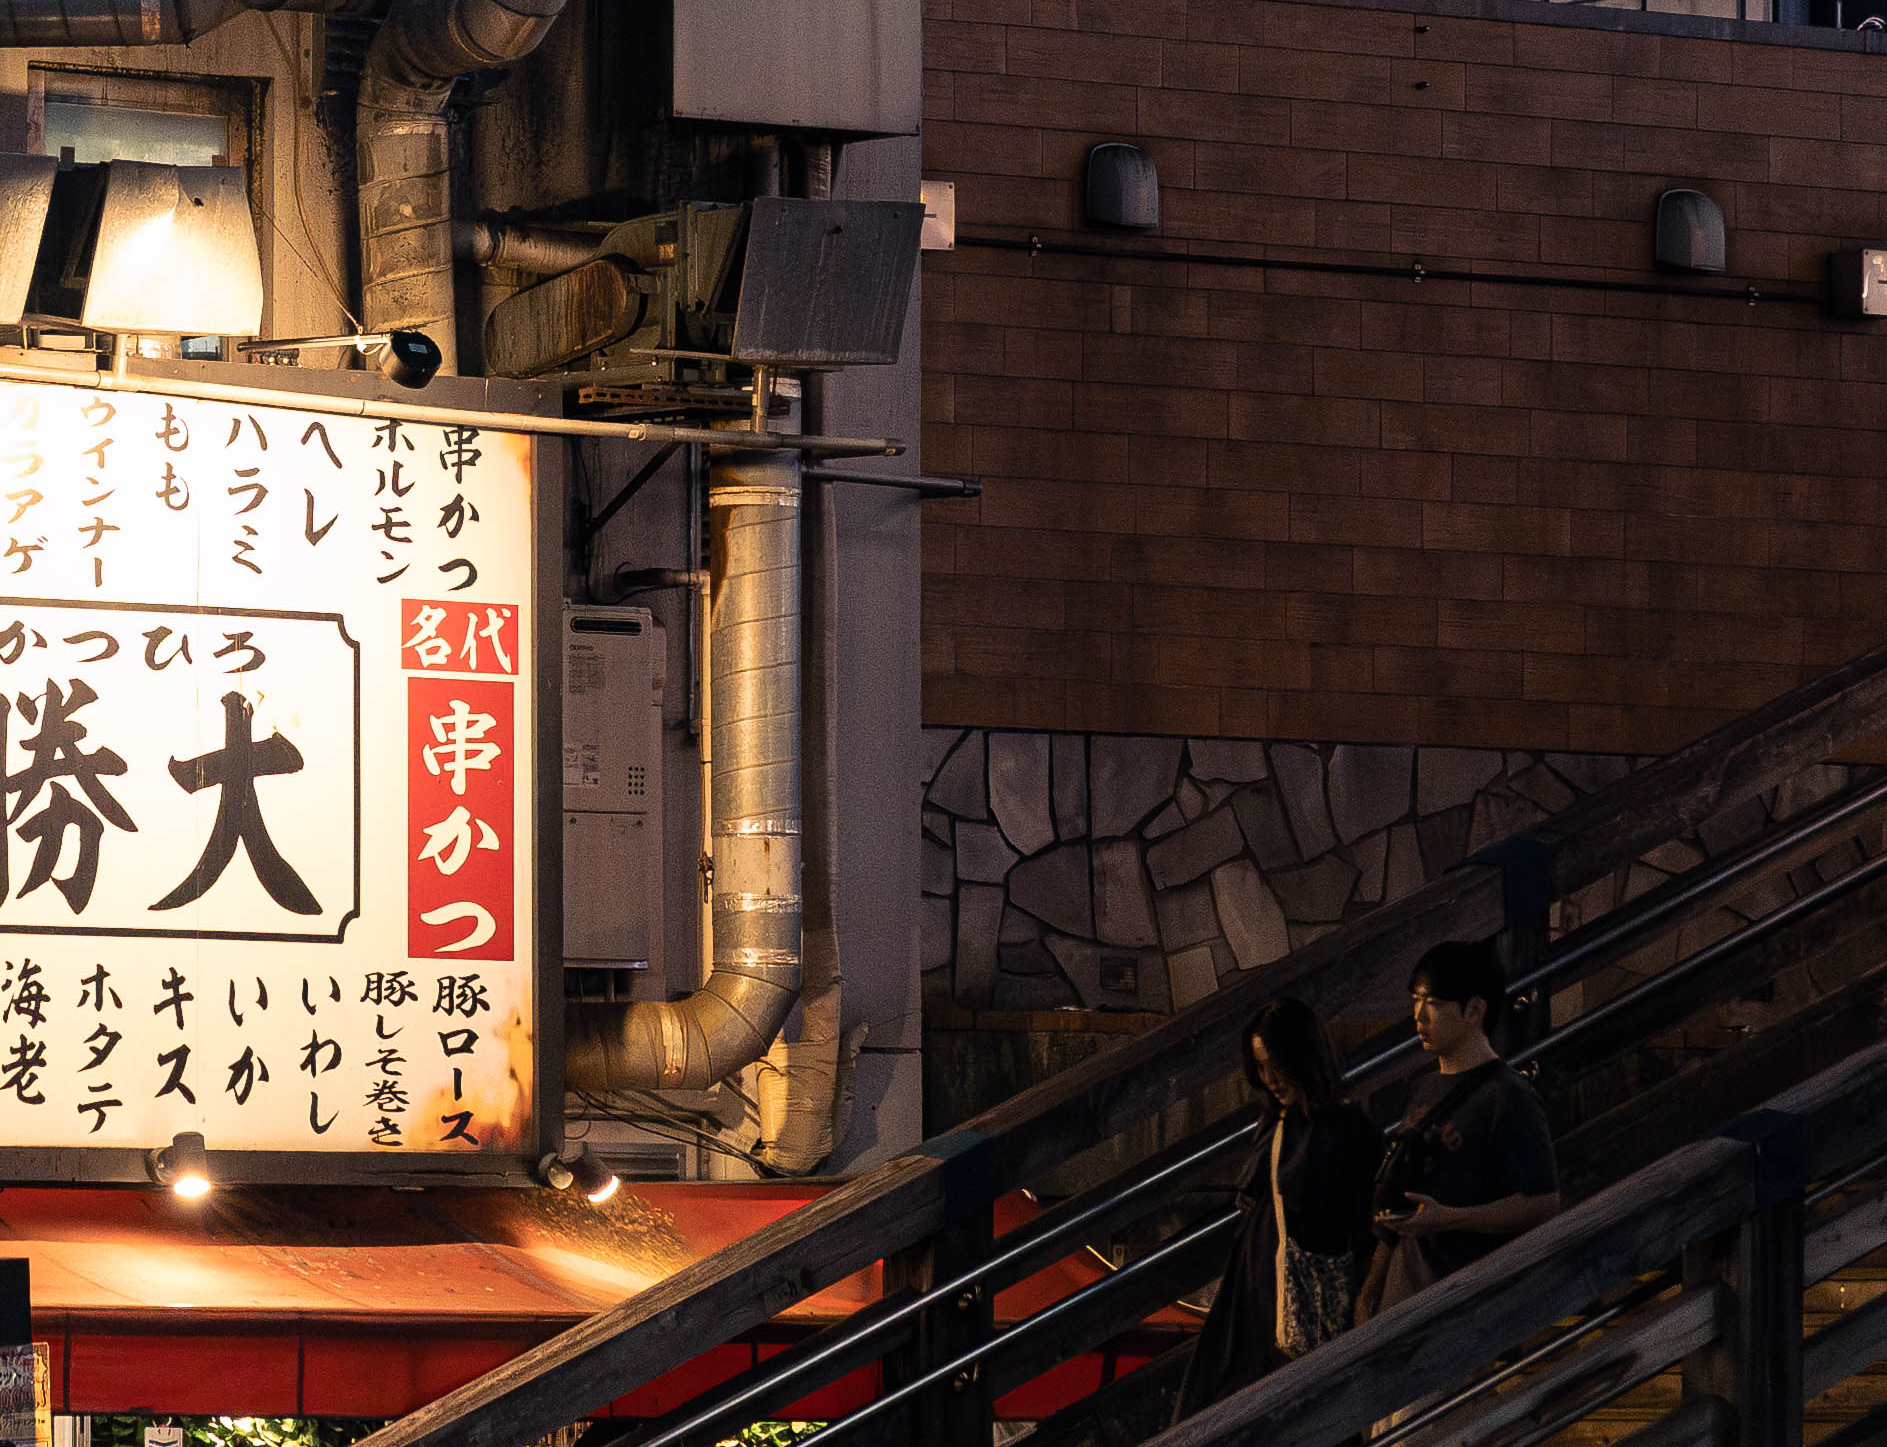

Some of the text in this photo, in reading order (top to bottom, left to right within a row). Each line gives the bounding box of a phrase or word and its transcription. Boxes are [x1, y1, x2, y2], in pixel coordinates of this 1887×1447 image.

[77, 395, 122, 589] ウインナー
[154, 402, 191, 512] もも
[223, 413, 269, 576] ハラミ
[300, 421, 344, 548] ヘレ
[370, 418, 416, 585] ホルモン
[437, 426, 482, 593] 串かつ
[401, 604, 514, 670] 名代
[416, 700, 503, 955] 串かつ
[76, 963, 125, 1136] ホタテ
[152, 965, 198, 1106] キス
[225, 975, 271, 1108] いか
[298, 974, 344, 1136] いわし
[358, 969, 419, 1149] 豚しそ巻き
[431, 972, 492, 1147] 豚ロース
